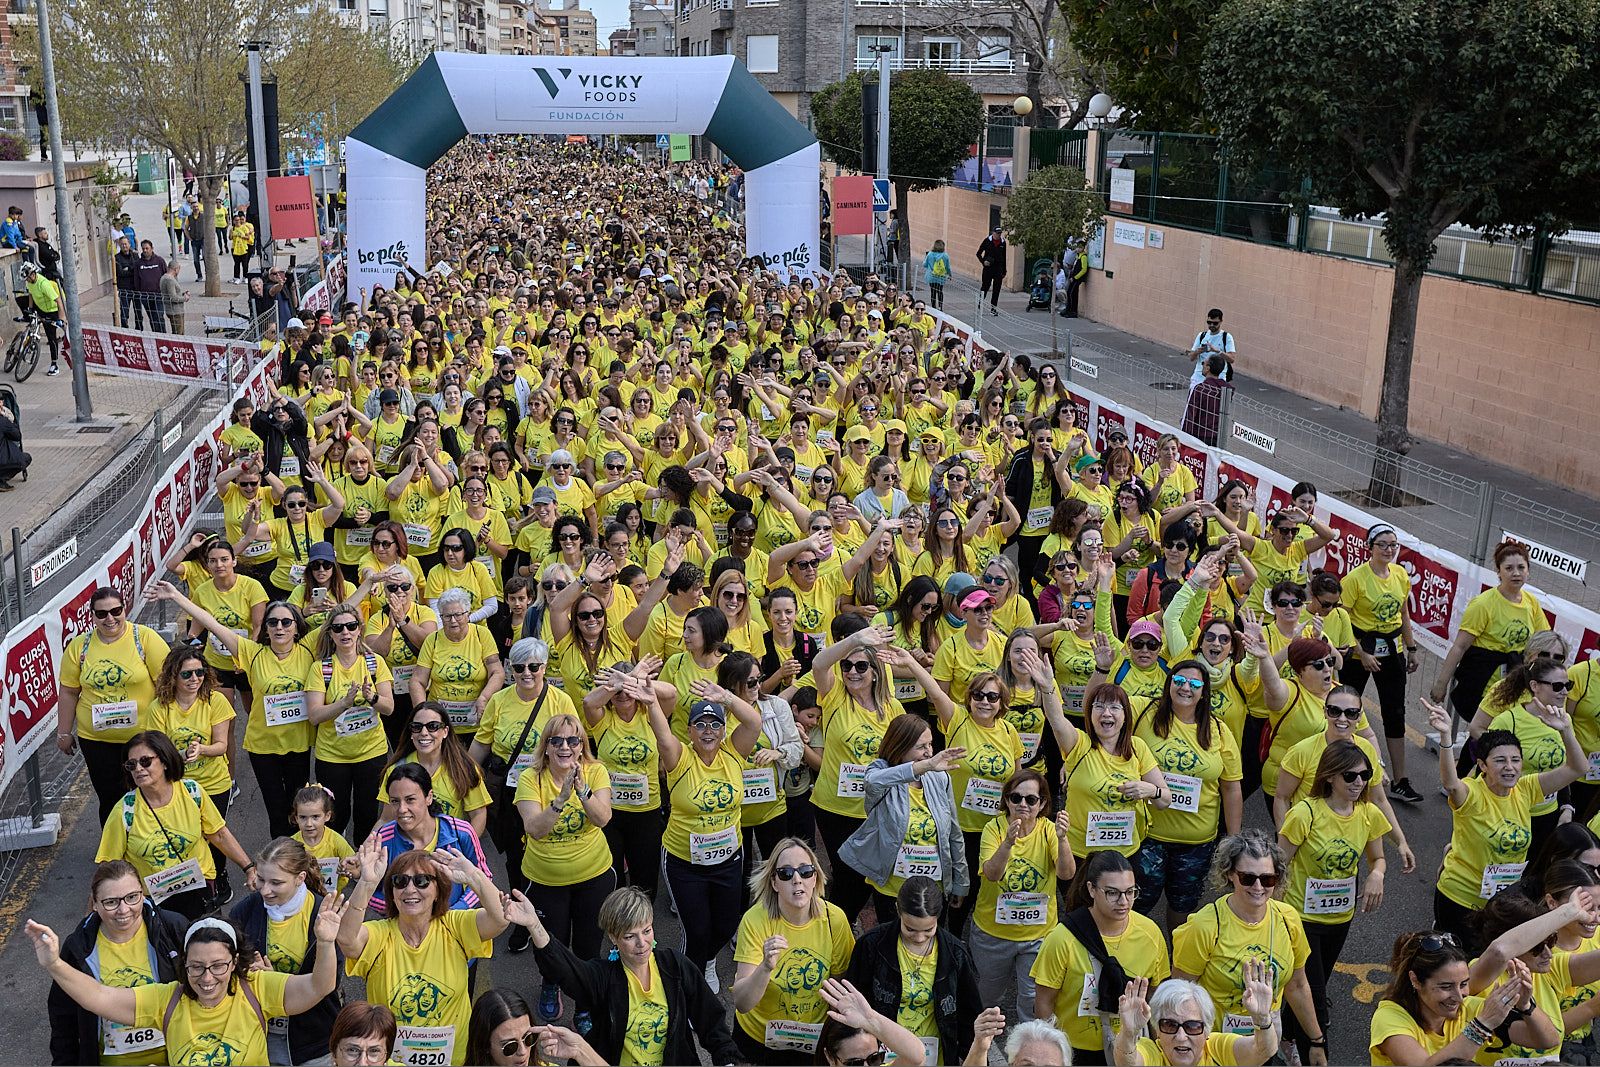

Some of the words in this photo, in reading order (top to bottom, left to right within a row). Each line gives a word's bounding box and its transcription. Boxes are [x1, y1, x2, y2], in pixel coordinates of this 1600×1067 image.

[578, 74, 643, 89] VICKY
[584, 92, 637, 102] FOODS
[549, 109, 624, 121] FUNDACIÓN
[275, 202, 310, 212] CAMINANTS
[357, 249, 374, 264] be
[376, 246, 409, 266] plus
[764, 252, 780, 266] be
[782, 248, 811, 267] plus
[1077, 360, 1096, 376] PROINBENI
[1145, 436, 1158, 448] CURS
[1240, 428, 1273, 451] PROINBENI
[1184, 455, 1204, 470] CURSA
[1196, 469, 1203, 478] LA
[1346, 534, 1368, 550] CURS
[1346, 545, 1361, 556] DE
[1364, 551, 1368, 560] L
[41, 543, 74, 578] PROINBENI
[1526, 545, 1581, 576] OINBENI
[1436, 589, 1449, 604] LA
[77, 598, 91, 618] CUR
[77, 617, 86, 631] DE
[20, 640, 47, 670] CURSA
[22, 664, 36, 684] DE
[39, 654, 49, 670] LA
[25, 669, 52, 696] DONA
[900, 685, 916, 694] 443
[94, 706, 104, 714] XV
[281, 708, 300, 718] 808
[105, 717, 132, 725] 5811
[347, 718, 373, 731] 2244
[851, 783, 864, 792] 33
[971, 780, 981, 788] XV
[616, 791, 643, 800] 2969
[744, 787, 770, 798] 1626
[976, 798, 1000, 810] 2526
[1099, 831, 1127, 840] 2525
[704, 846, 732, 860] 3796
[901, 846, 913, 854] XV
[908, 864, 938, 875] 2527
[149, 875, 160, 886] XV
[166, 877, 197, 894] 4914
[1320, 897, 1350, 908] 1199
[1010, 909, 1040, 919] 3869
[1088, 978, 1095, 988] X
[1227, 1017, 1240, 1027] XV
[124, 1028, 155, 1045] 468
[398, 1030, 412, 1039] XV
[785, 1041, 813, 1051] 476
[408, 1053, 445, 1065] 4820
